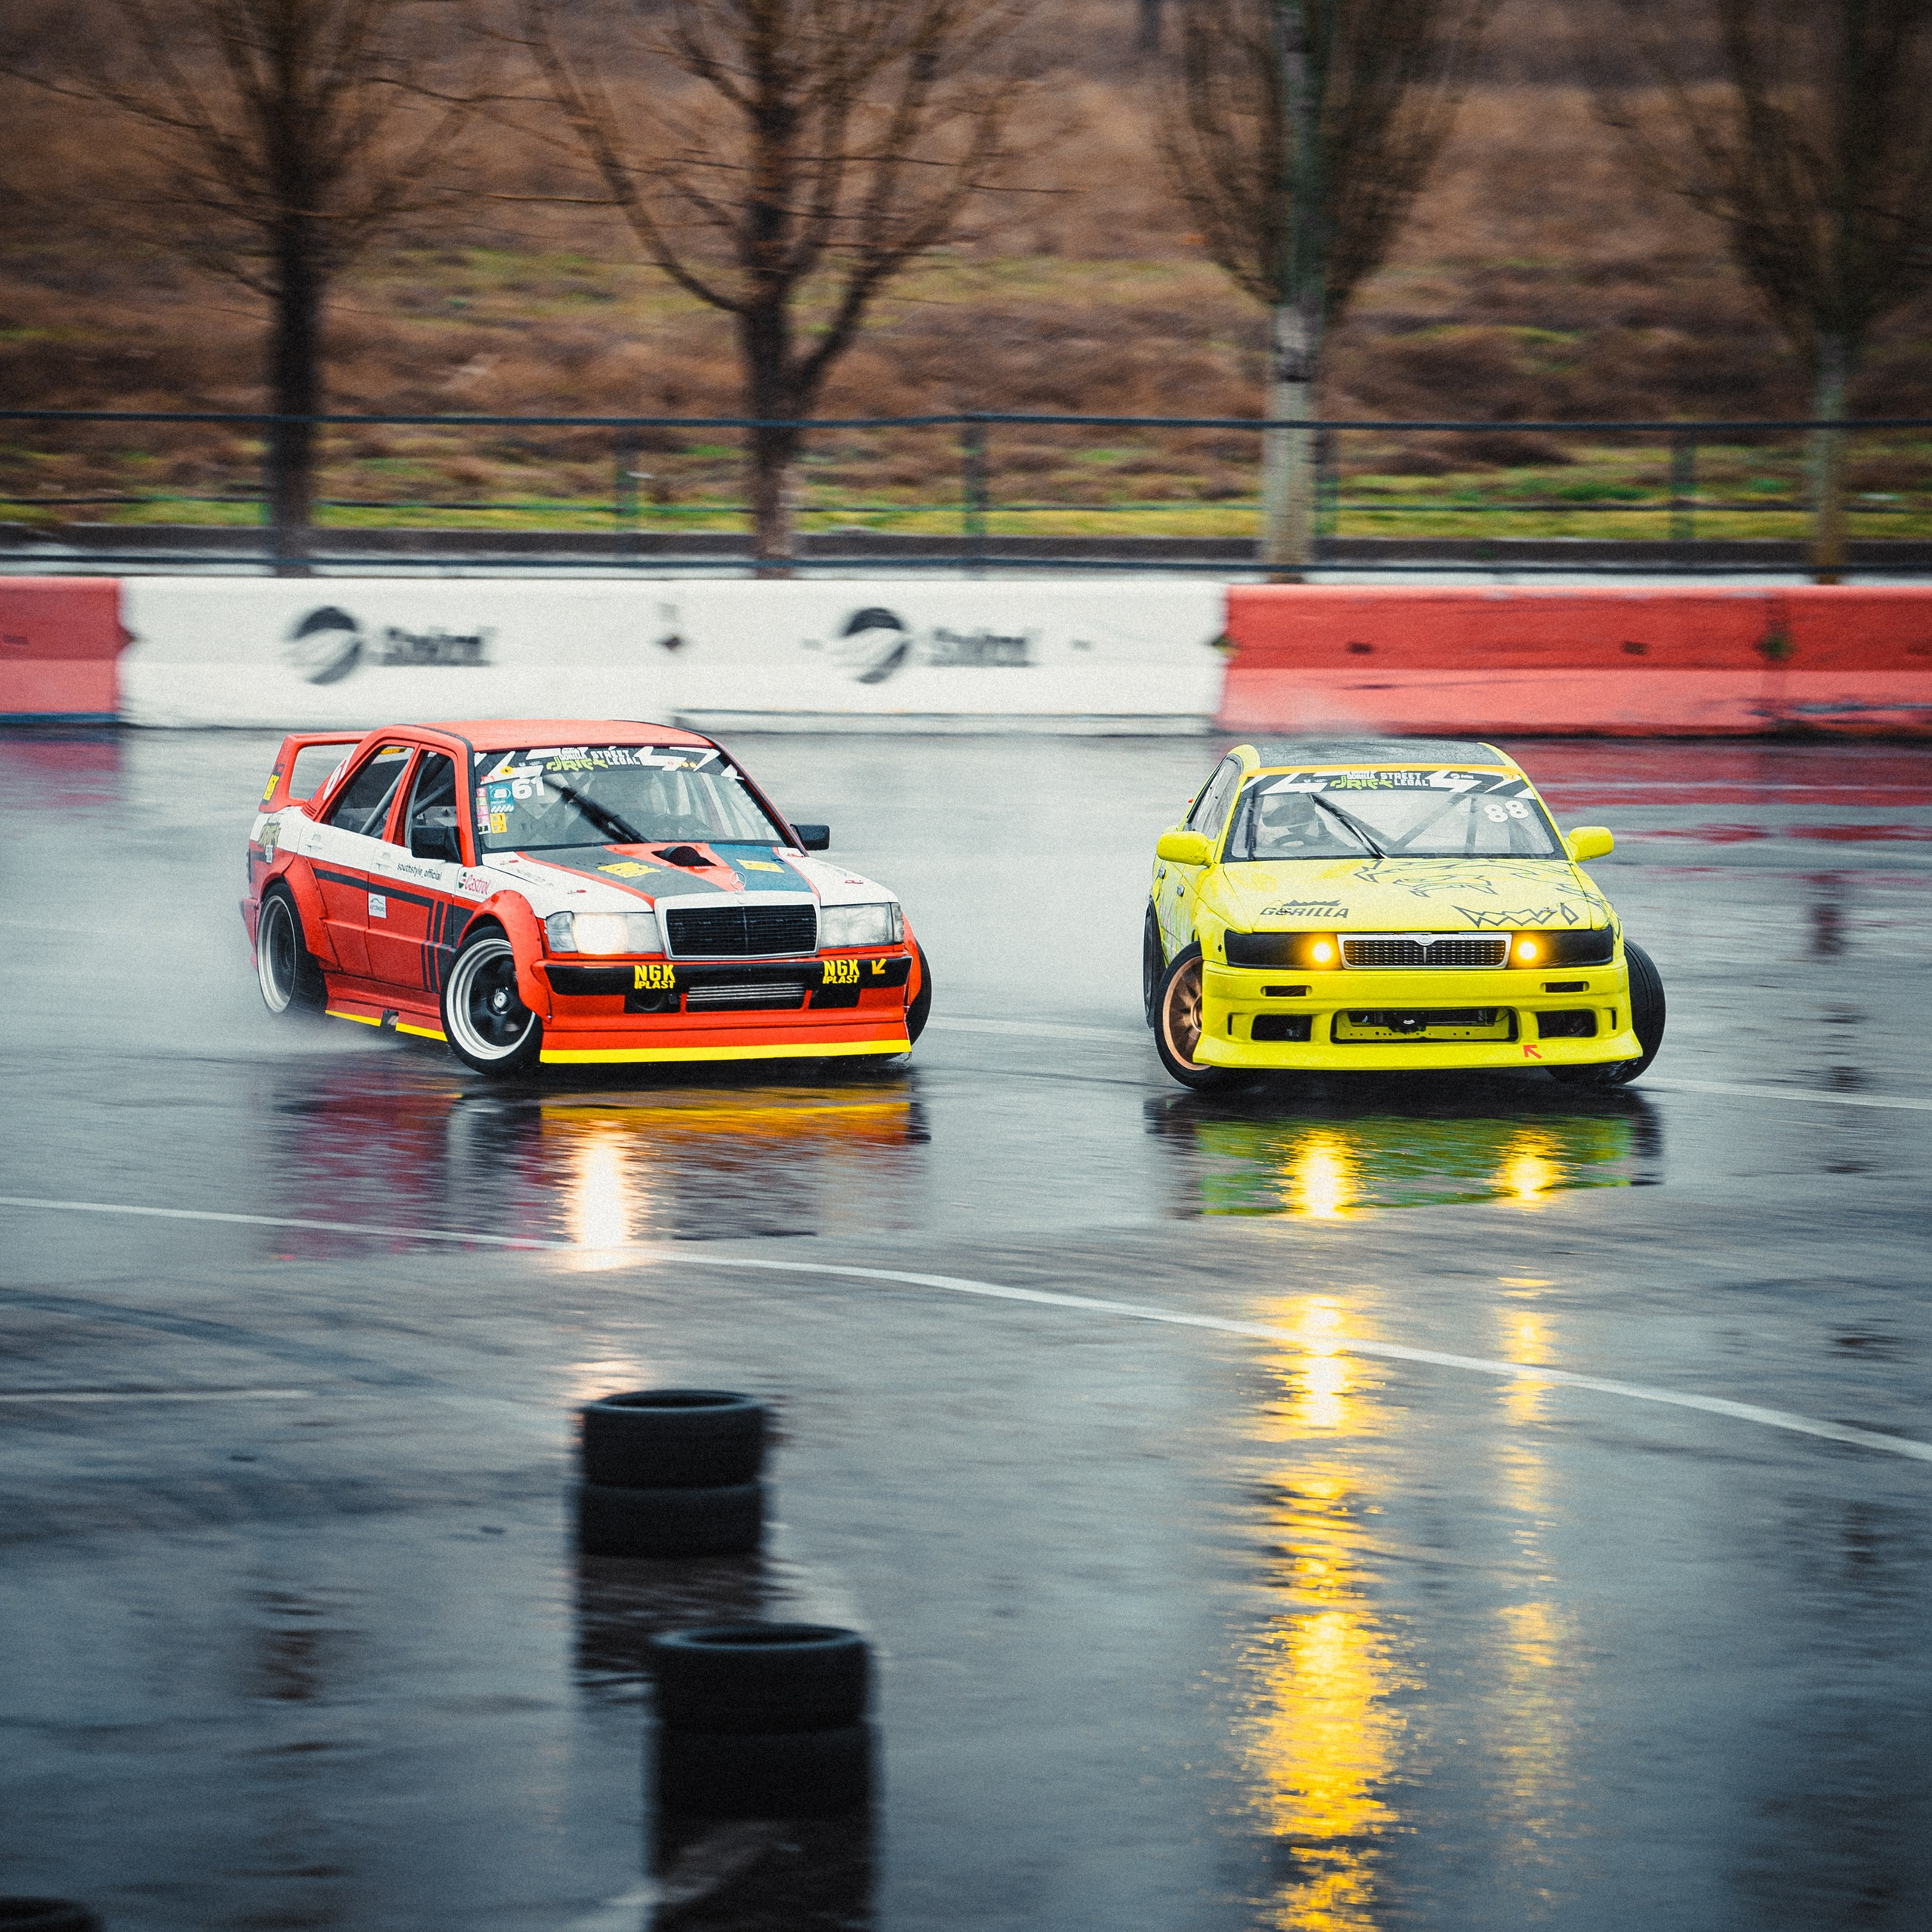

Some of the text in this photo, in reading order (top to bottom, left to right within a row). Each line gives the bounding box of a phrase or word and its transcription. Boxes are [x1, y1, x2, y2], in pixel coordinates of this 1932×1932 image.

[512, 776, 545, 800] 61
[1484, 800, 1529, 823] 88
[464, 874, 491, 894] Castrol
[1260, 907, 1349, 918] GORILLA
[634, 964, 676, 981] NGK
[823, 958, 860, 976] NGK
